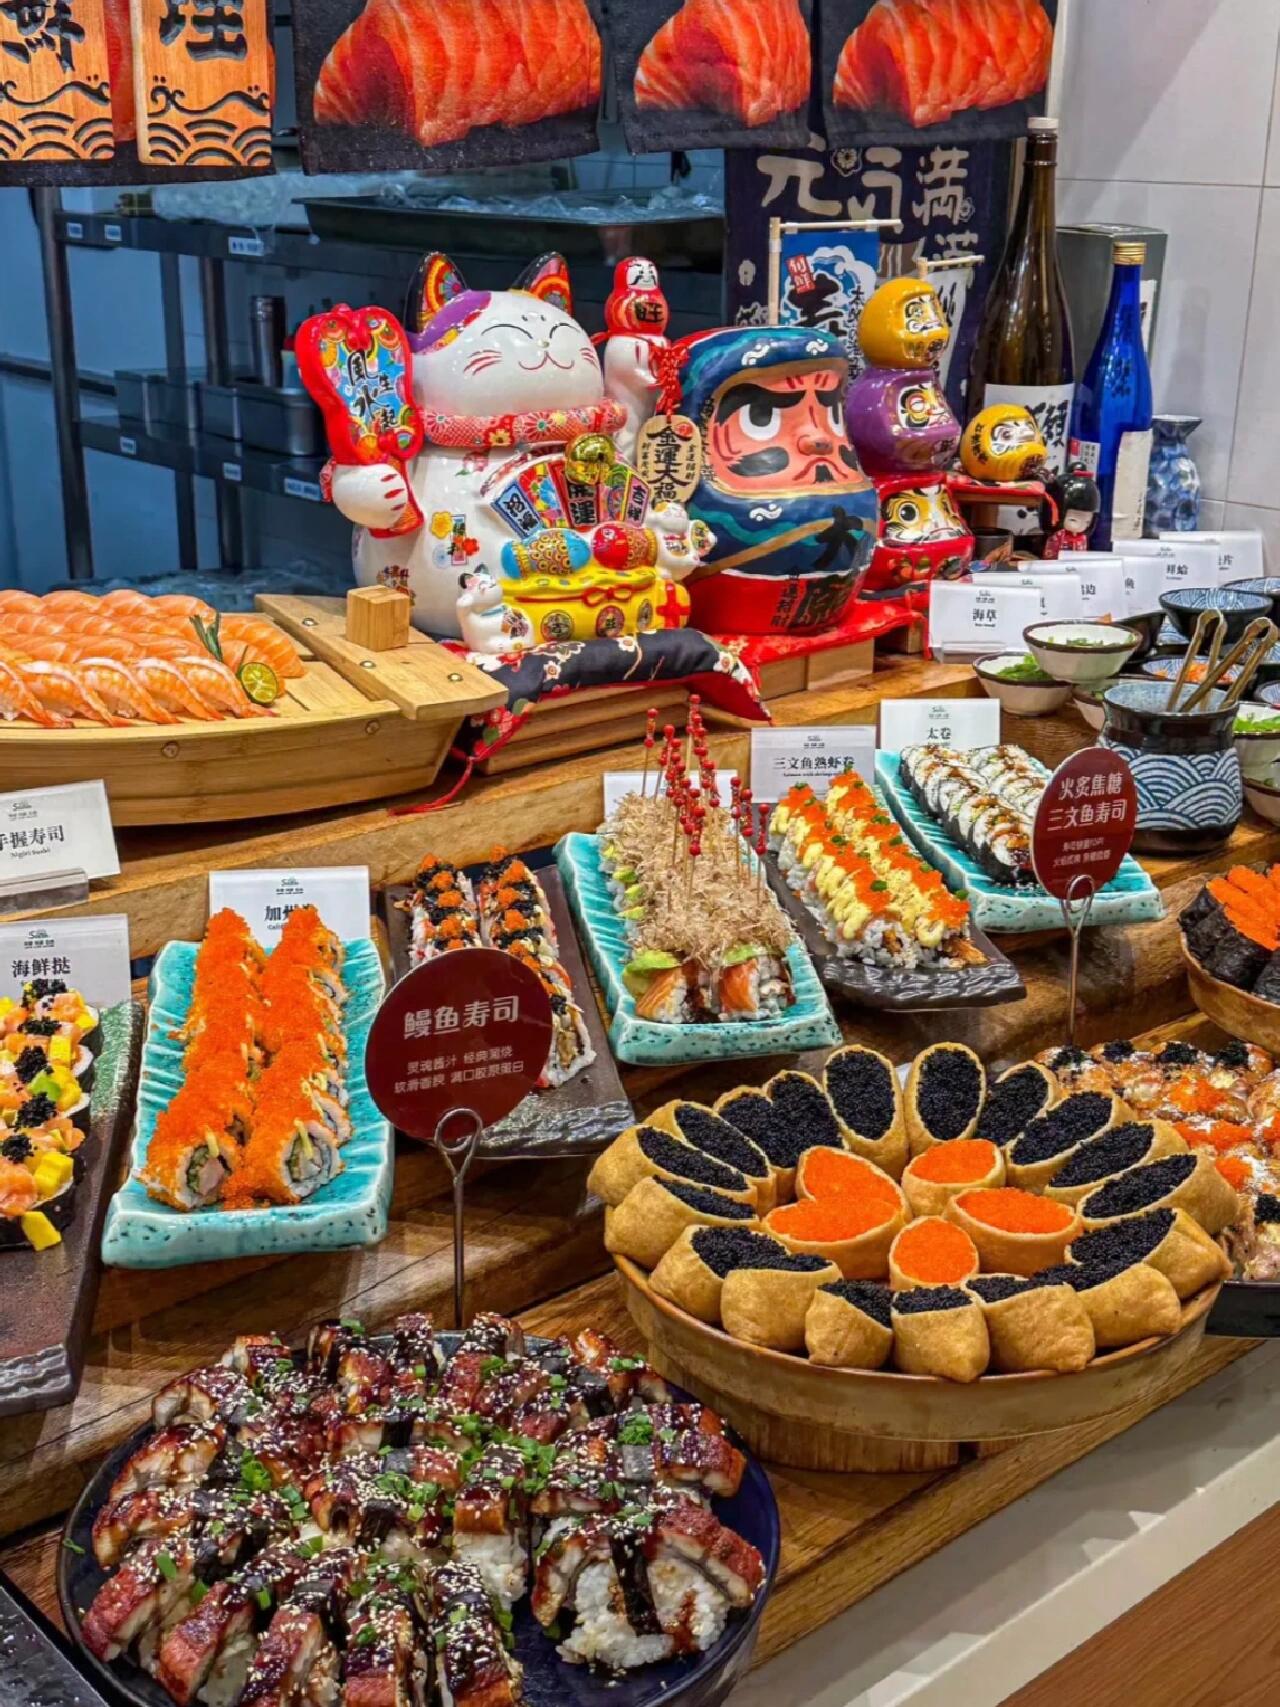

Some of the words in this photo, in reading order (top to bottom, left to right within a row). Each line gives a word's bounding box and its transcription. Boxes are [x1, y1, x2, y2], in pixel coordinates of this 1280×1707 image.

[972, 608, 997, 622] 海草
[926, 727, 951, 740] 太卷
[772, 755, 855, 770] 三文鱼熟虾卷
[1058, 772, 1124, 801] 火炙焦糖
[1047, 798, 1128, 831] 三文鱼寿司
[12, 956, 71, 978] 海鲜挞
[404, 995, 519, 1040] 鳗鱼寿司
